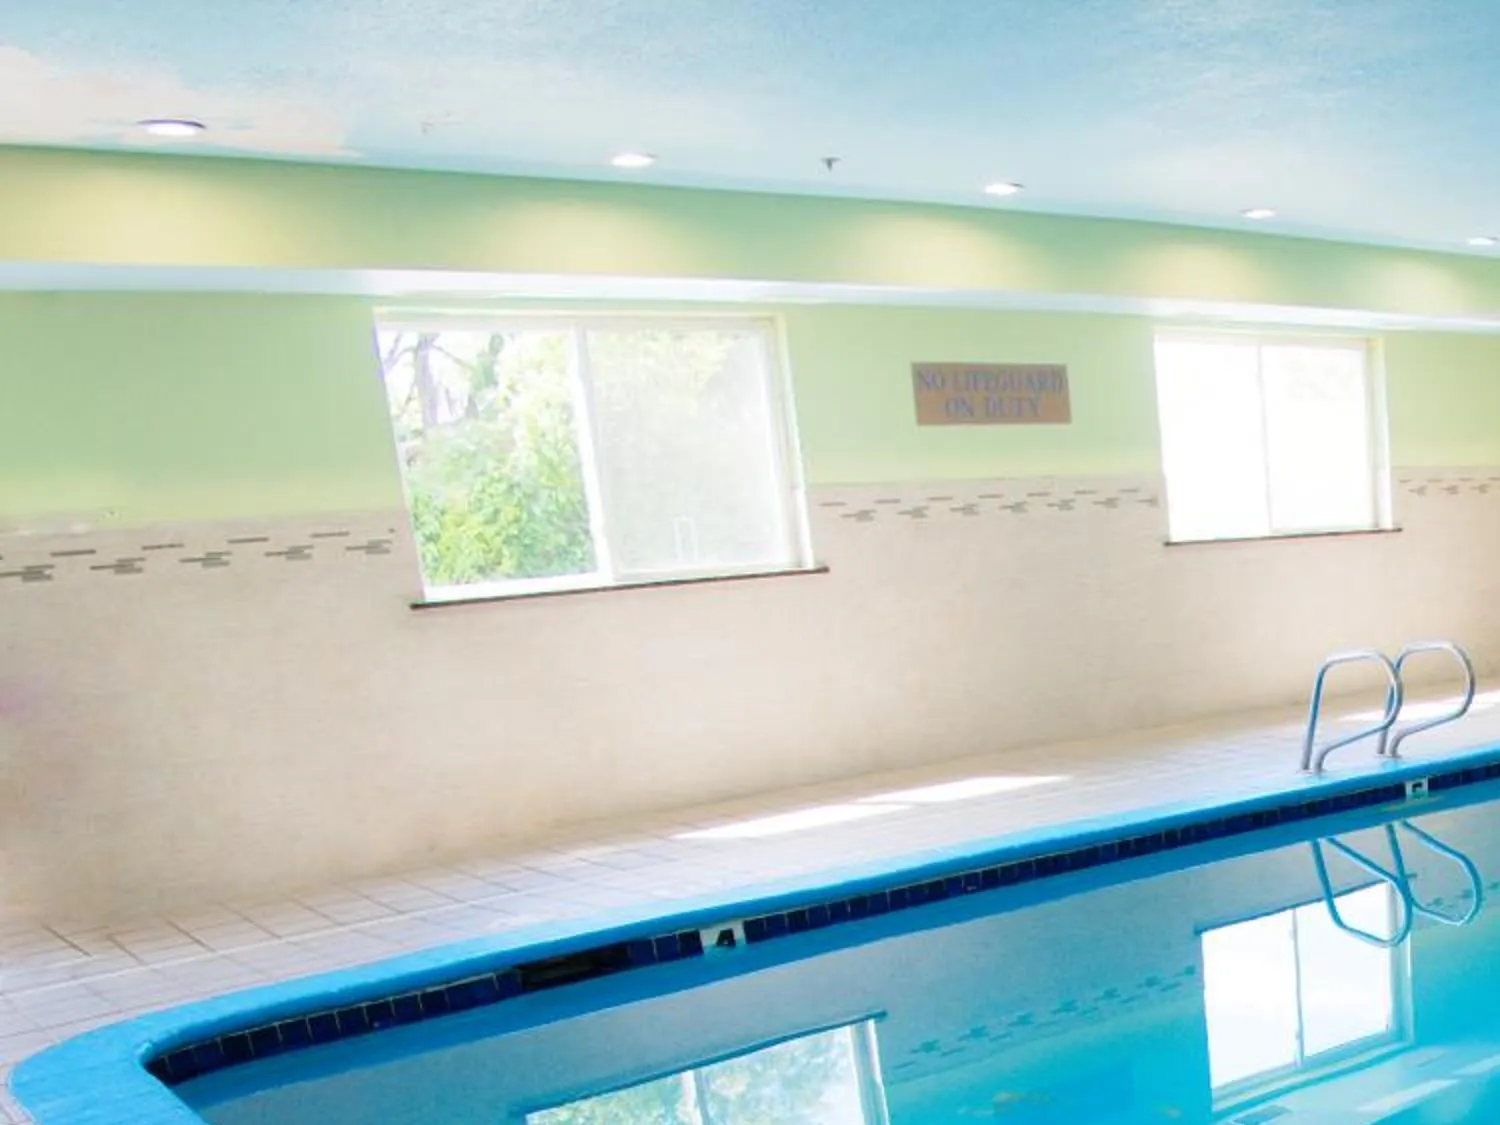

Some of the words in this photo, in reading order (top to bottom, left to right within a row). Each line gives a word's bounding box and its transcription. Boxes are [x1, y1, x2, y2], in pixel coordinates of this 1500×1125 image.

[917, 370, 946, 391] NO
[946, 397, 974, 417] ON
[986, 397, 1041, 418] DUTY
